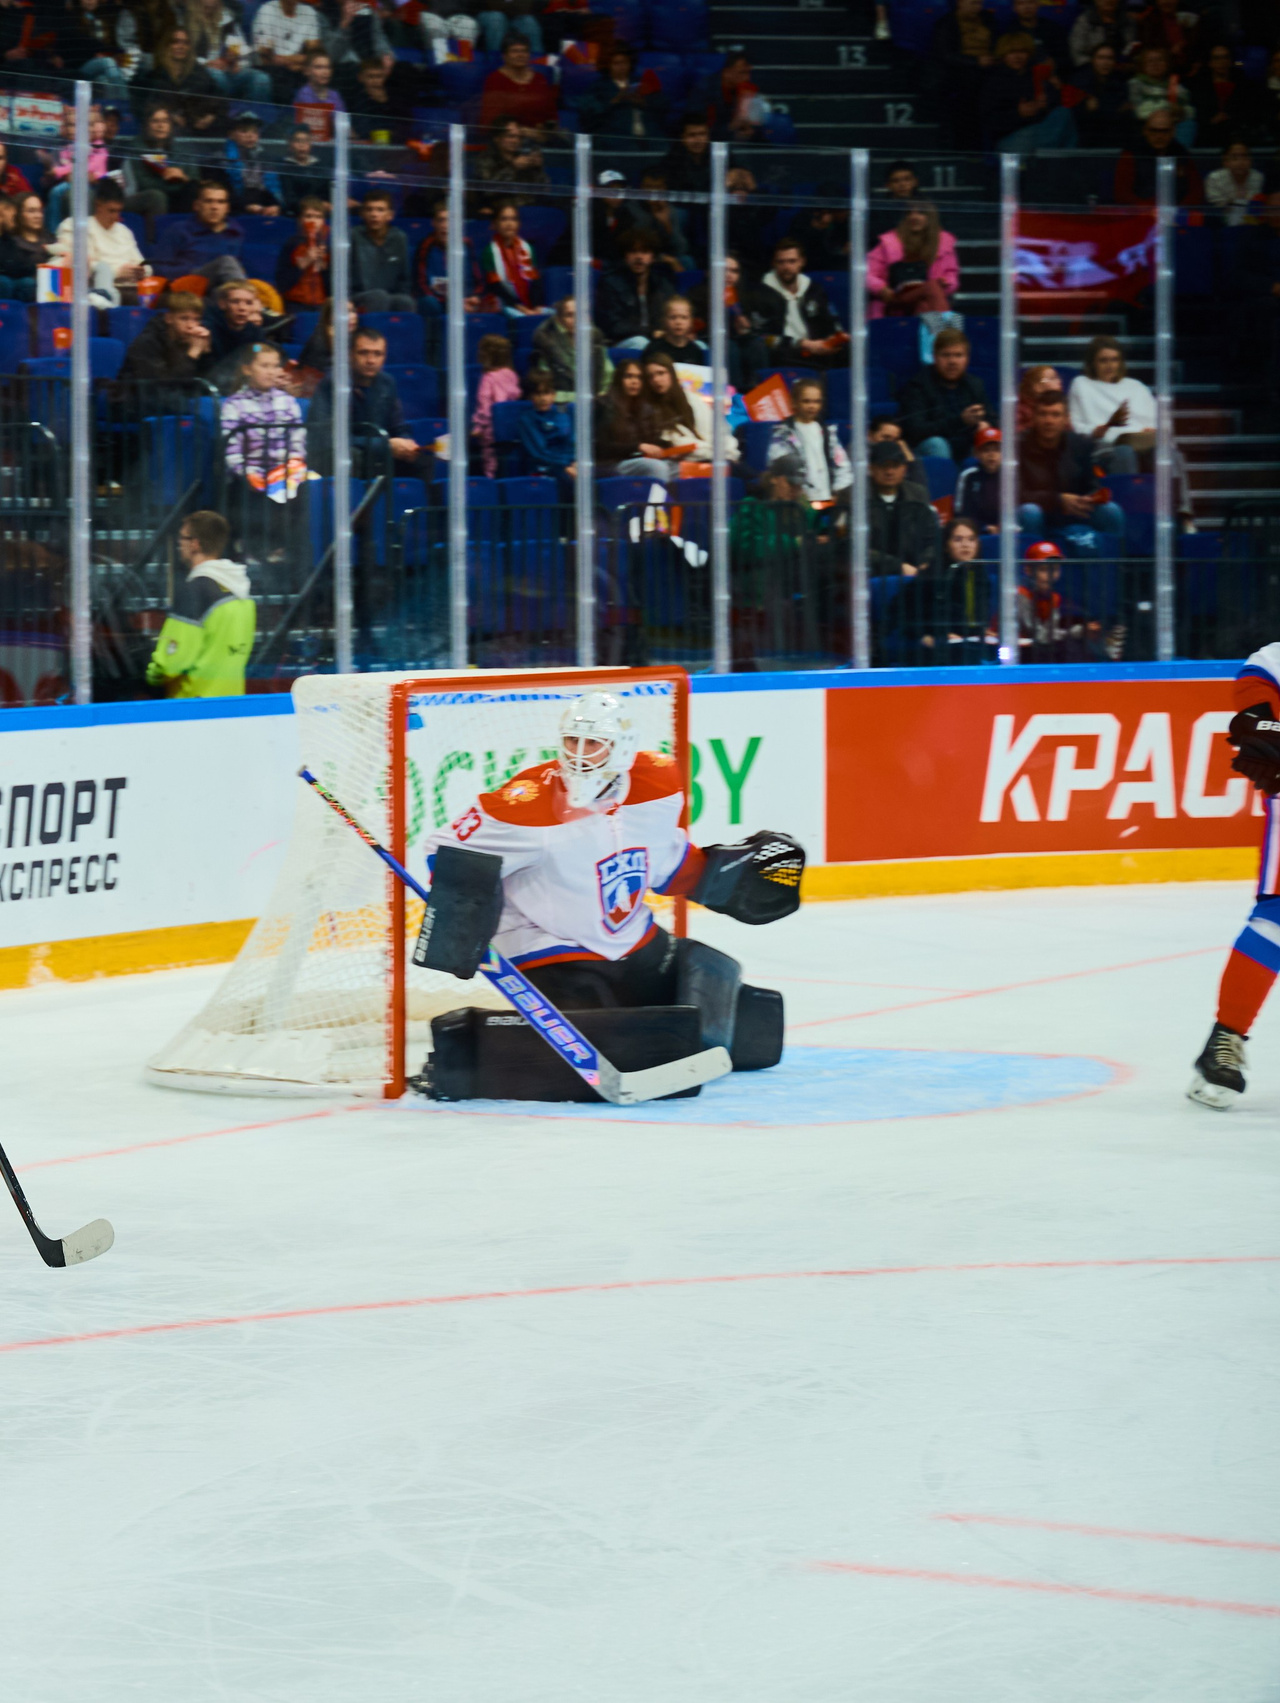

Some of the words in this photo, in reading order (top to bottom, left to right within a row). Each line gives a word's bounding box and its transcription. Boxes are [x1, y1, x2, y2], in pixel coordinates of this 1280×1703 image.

[837, 45, 867, 66] 13
[885, 103, 913, 125] 12
[933, 166, 956, 187] 11
[980, 711, 1265, 822] КРАС
[495, 974, 594, 1065] BAUER
